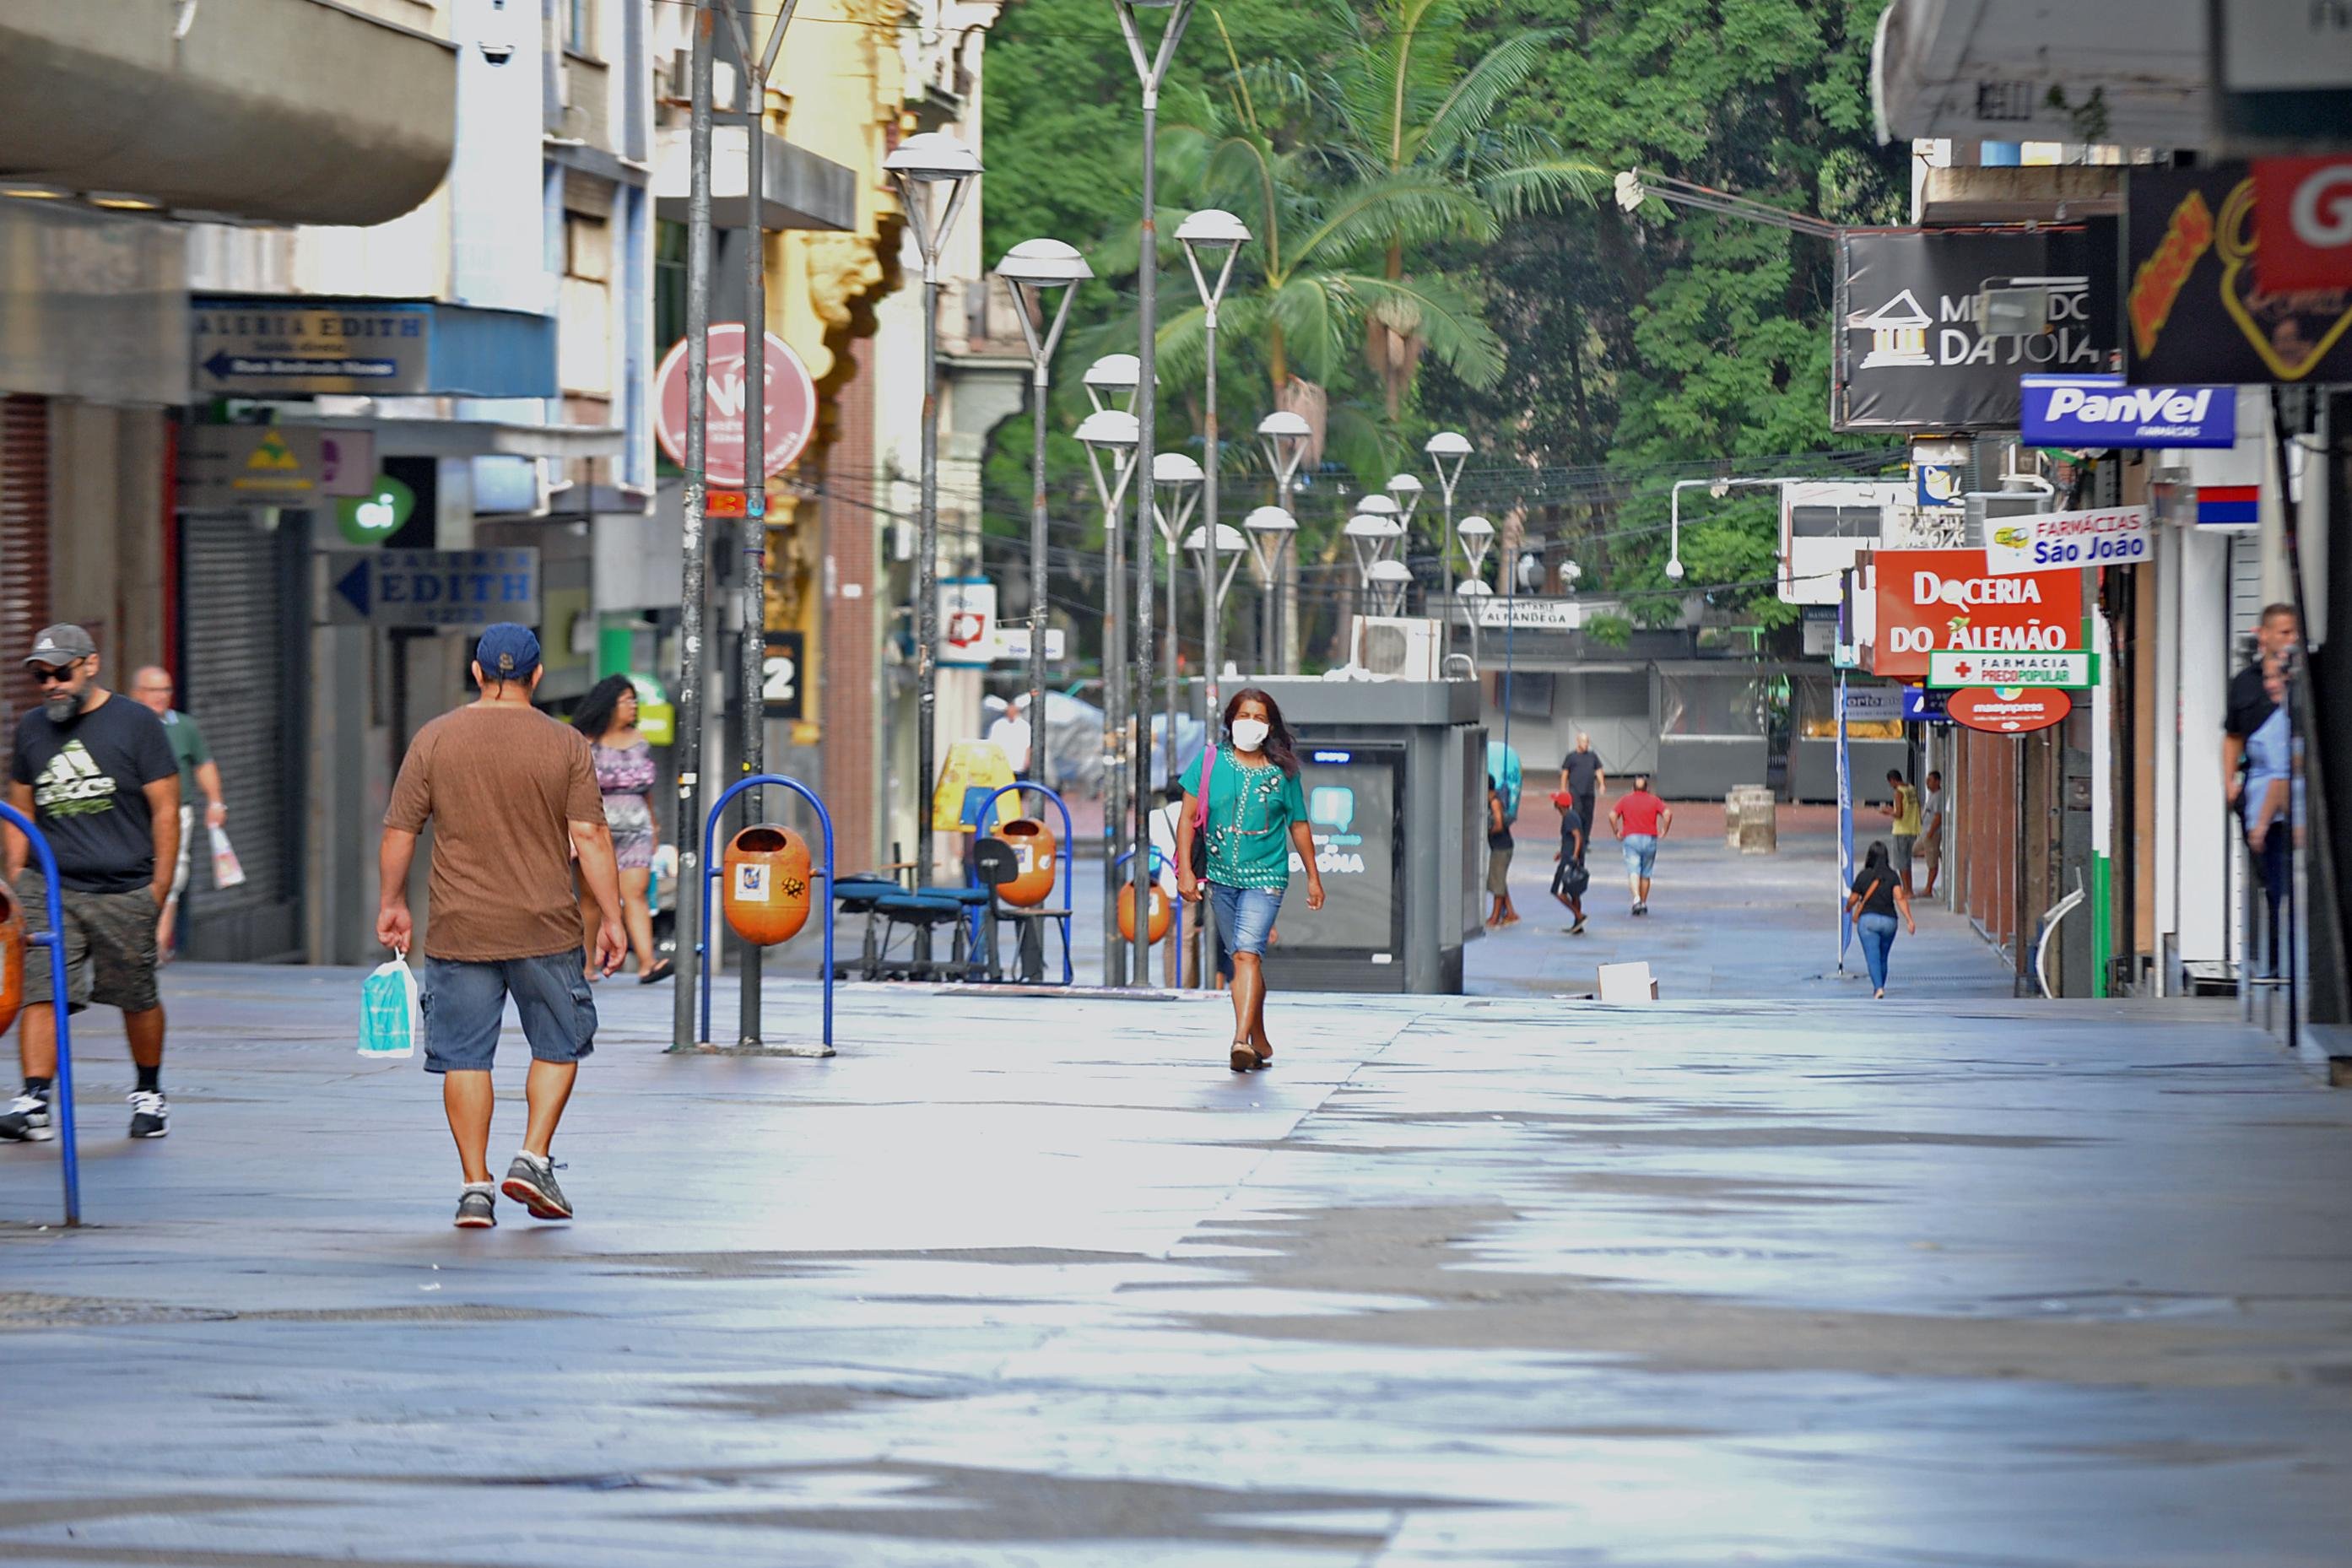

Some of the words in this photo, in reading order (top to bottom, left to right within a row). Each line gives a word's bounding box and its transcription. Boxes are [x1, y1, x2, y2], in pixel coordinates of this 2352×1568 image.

[195, 315, 305, 335] ALERIA
[318, 317, 421, 338] EDITH
[2044, 387, 2214, 424] PanVel
[2035, 514, 2142, 538] FARMÁCIAS
[2034, 538, 2079, 565] São
[2087, 533, 2145, 560] João
[382, 573, 531, 603] EDITH
[1890, 626, 1934, 653] DO
[1946, 618, 2068, 651] ALEMÃO
